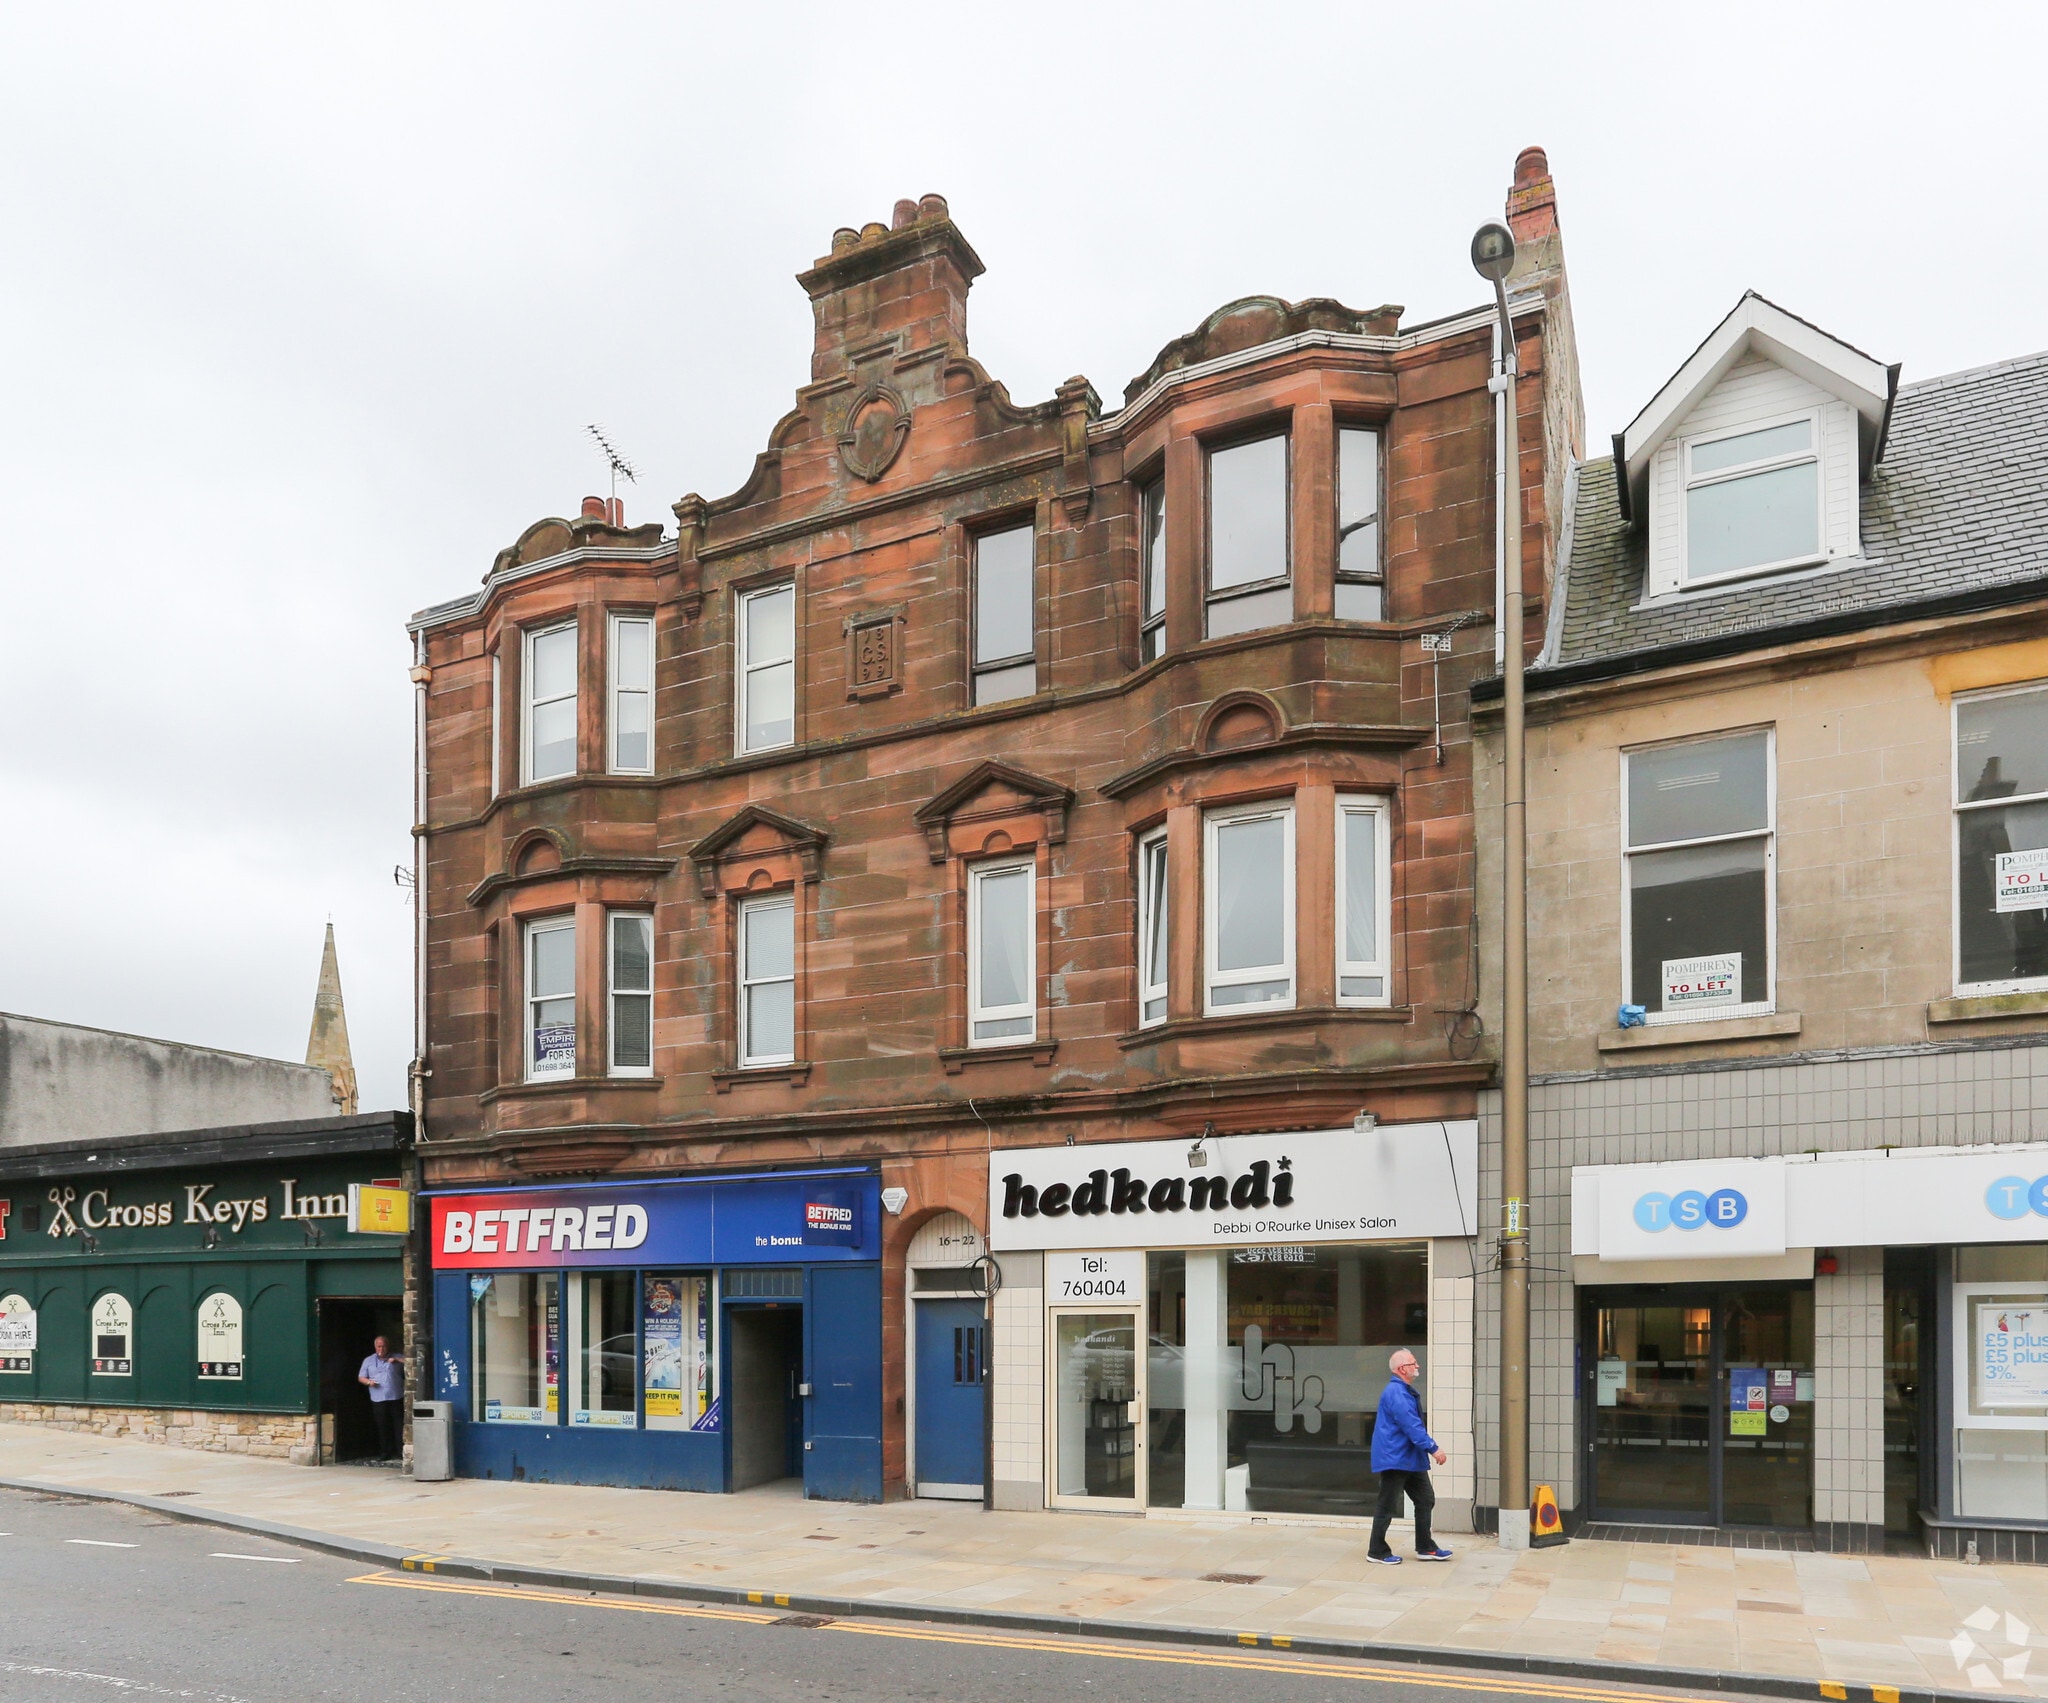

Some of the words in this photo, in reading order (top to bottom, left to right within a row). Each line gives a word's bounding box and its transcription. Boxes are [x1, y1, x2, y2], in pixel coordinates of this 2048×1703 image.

[2005, 873, 2030, 885] TO
[1666, 958, 1736, 977] POMPHREYS
[1669, 984, 1690, 993] TO
[1697, 980, 1727, 991] LET
[549, 1050, 564, 1060] FOR
[1001, 1155, 1295, 1219] hedkandi
[82, 1188, 174, 1229] Cross
[183, 1184, 269, 1233] Keys
[280, 1178, 349, 1219] Inn
[807, 1206, 852, 1222] BETFRED
[442, 1203, 650, 1254] BETFRED
[819, 1222, 839, 1230] BONUS
[839, 1223, 852, 1231] KING
[1213, 1222, 1252, 1234] Debbi
[1255, 1220, 1311, 1233] O'Rourke
[1315, 1218, 1356, 1231] Unisex
[1360, 1216, 1397, 1229] Salon
[755, 1235, 768, 1246] the
[1081, 1257, 1108, 1273] Tel:
[1062, 1280, 1127, 1297] 760404
[95, 1319, 112, 1327] Cross
[113, 1318, 128, 1328] Keys
[202, 1320, 219, 1328] Cross
[221, 1320, 238, 1329] Keys
[14, 1330, 32, 1340] HIRE
[213, 1328, 225, 1336] Inn
[1985, 1333, 2009, 1347] £5
[1985, 1349, 2009, 1363] £5
[1985, 1365, 2017, 1379] 3%.
[667, 1393, 680, 1401] FUN
[488, 1409, 500, 1420] sky
[576, 1413, 589, 1423] sky
